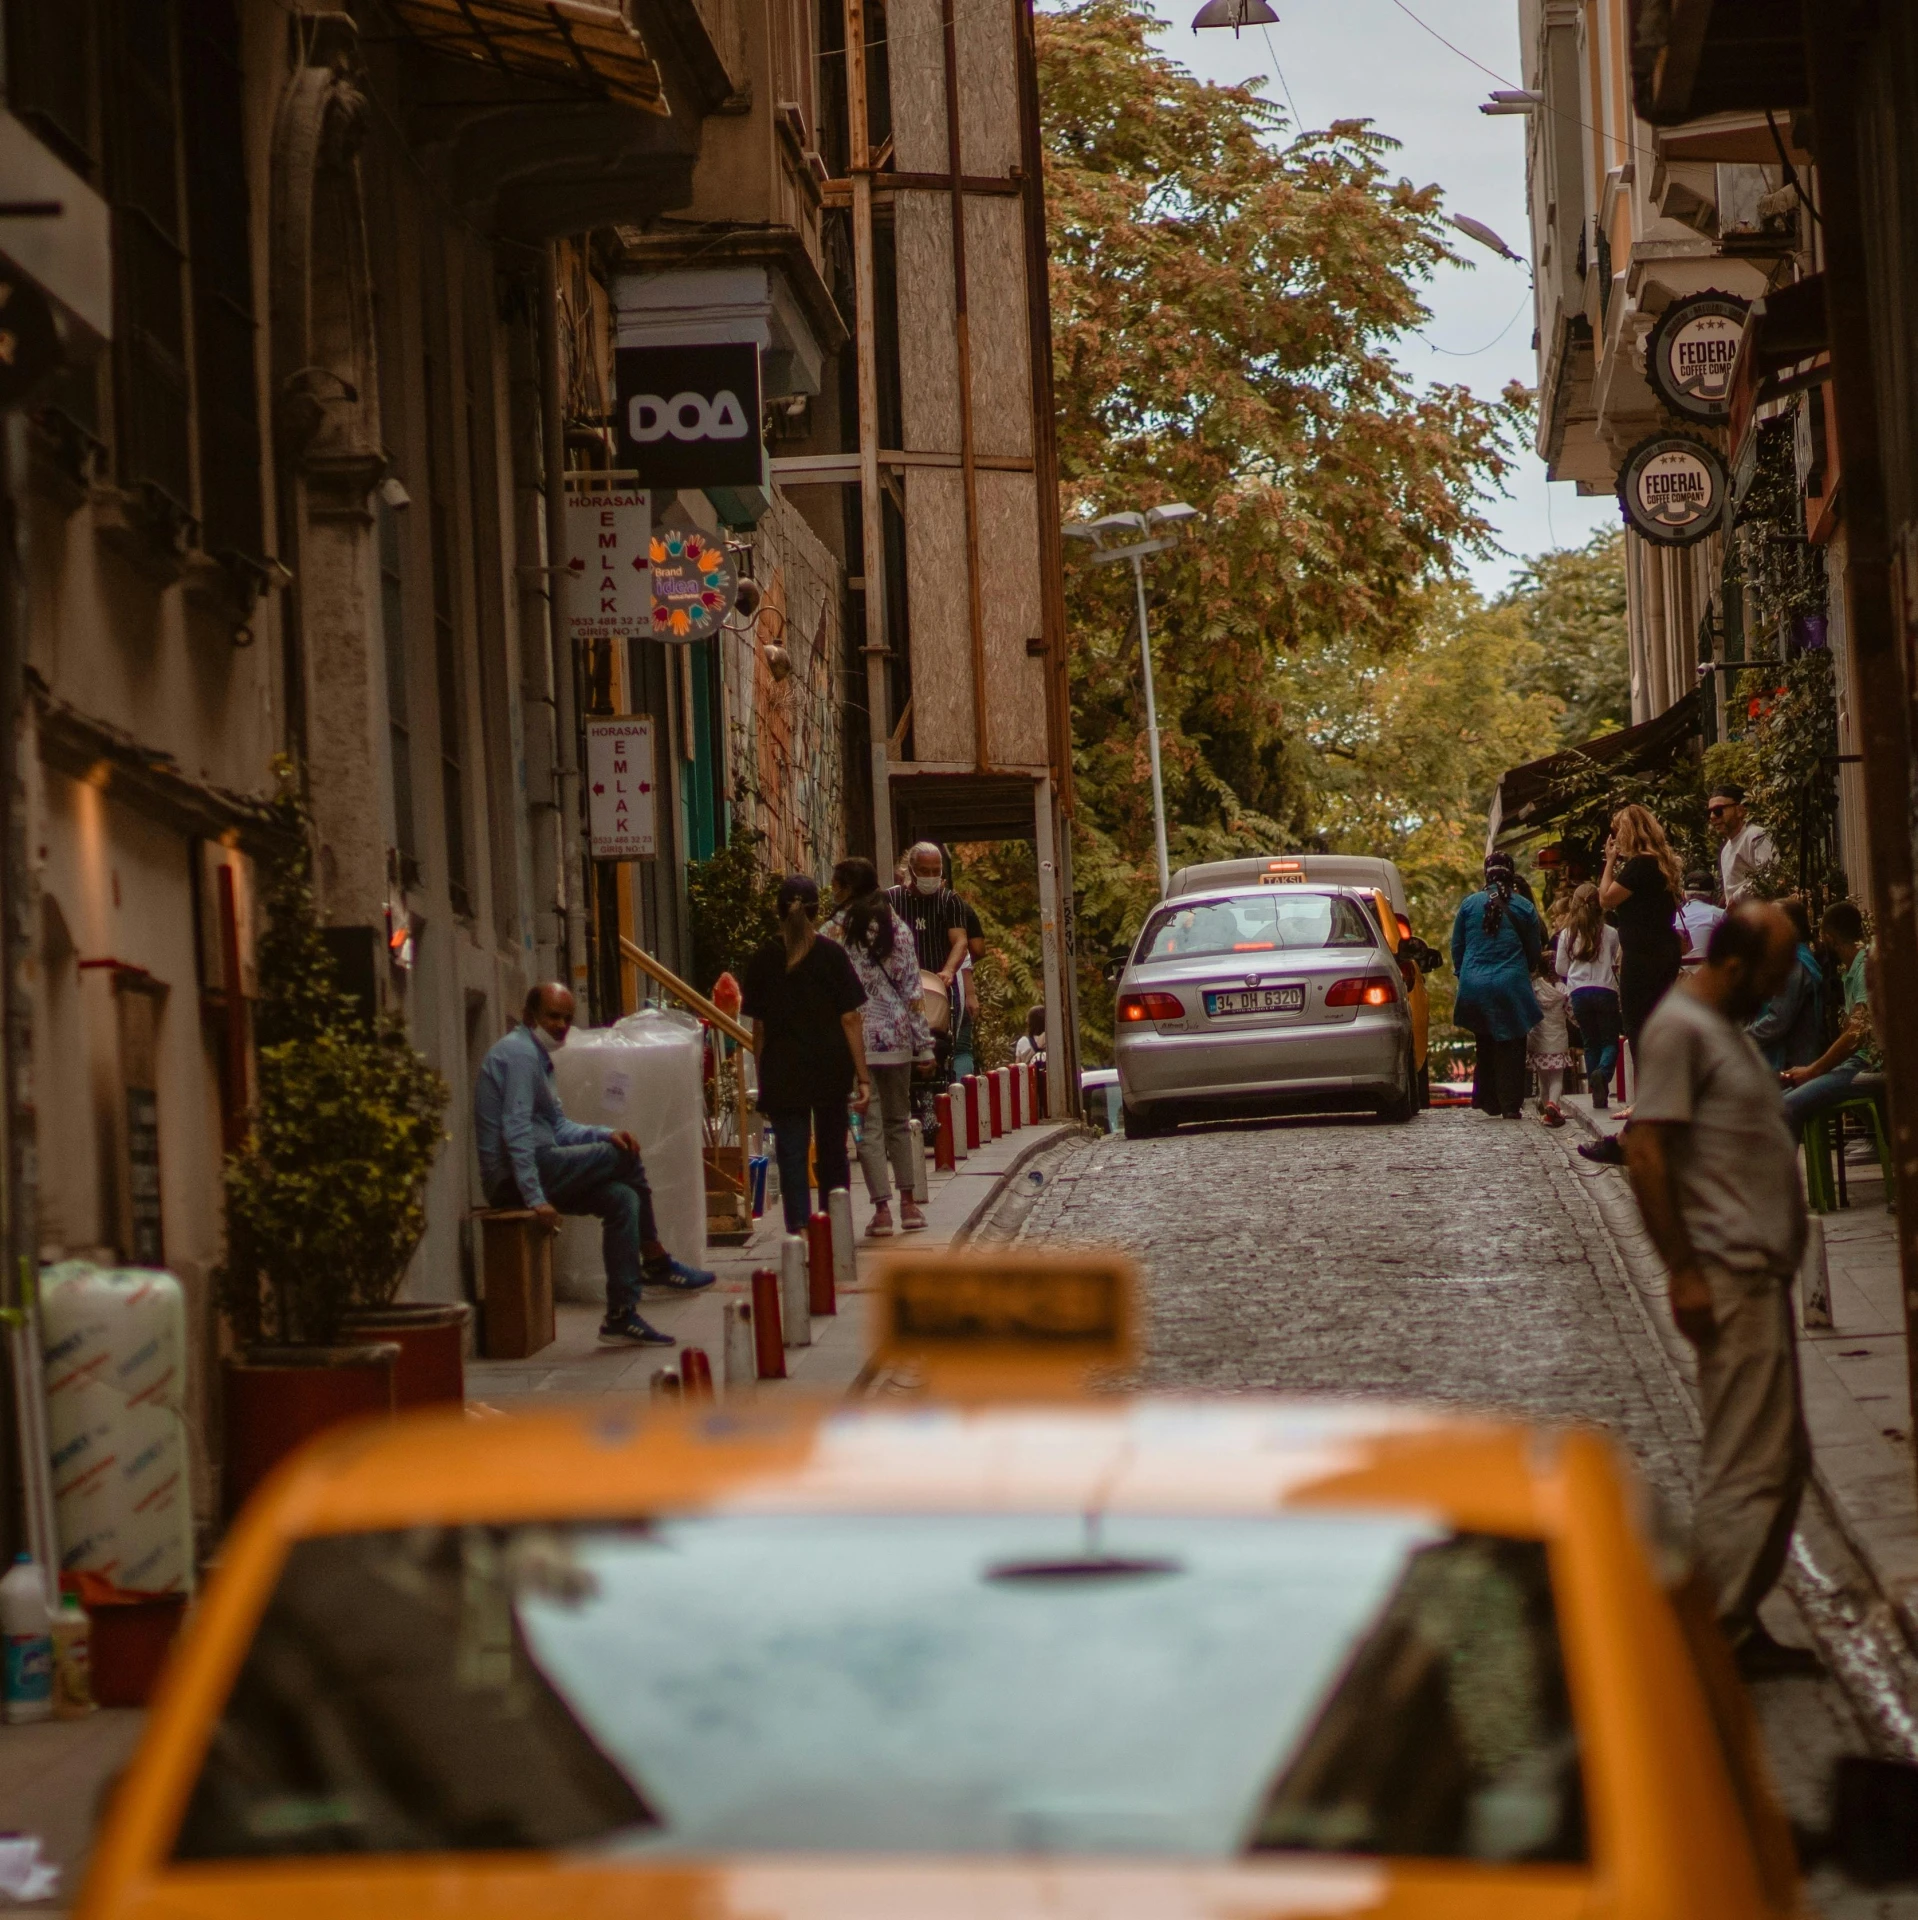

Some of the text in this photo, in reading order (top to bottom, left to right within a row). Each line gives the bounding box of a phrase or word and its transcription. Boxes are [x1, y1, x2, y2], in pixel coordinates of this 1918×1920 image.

[1679, 340, 1739, 364] FEDERA
[1680, 363, 1732, 376] COFFEE COMP
[1645, 472, 1704, 494] FEDERAL
[569, 496, 645, 508] HORASAN
[1647, 491, 1705, 505] COFFEE COMPANY
[598, 511, 617, 613] EMLAK
[655, 566, 682, 577] Brand
[656, 578, 699, 596] idea
[597, 617, 617, 626] 488
[621, 617, 633, 625] 32
[636, 616, 649, 625] 23
[613, 627, 640, 636] NO:1
[592, 727, 647, 736] HORASAN
[614, 741, 628, 832] EMLAK
[642, 835, 652, 843] 23
[625, 844, 646, 853] NO:1
[1217, 995, 1233, 1010] 34
[1241, 992, 1258, 1008] DH
[1264, 990, 1299, 1006] 6320
